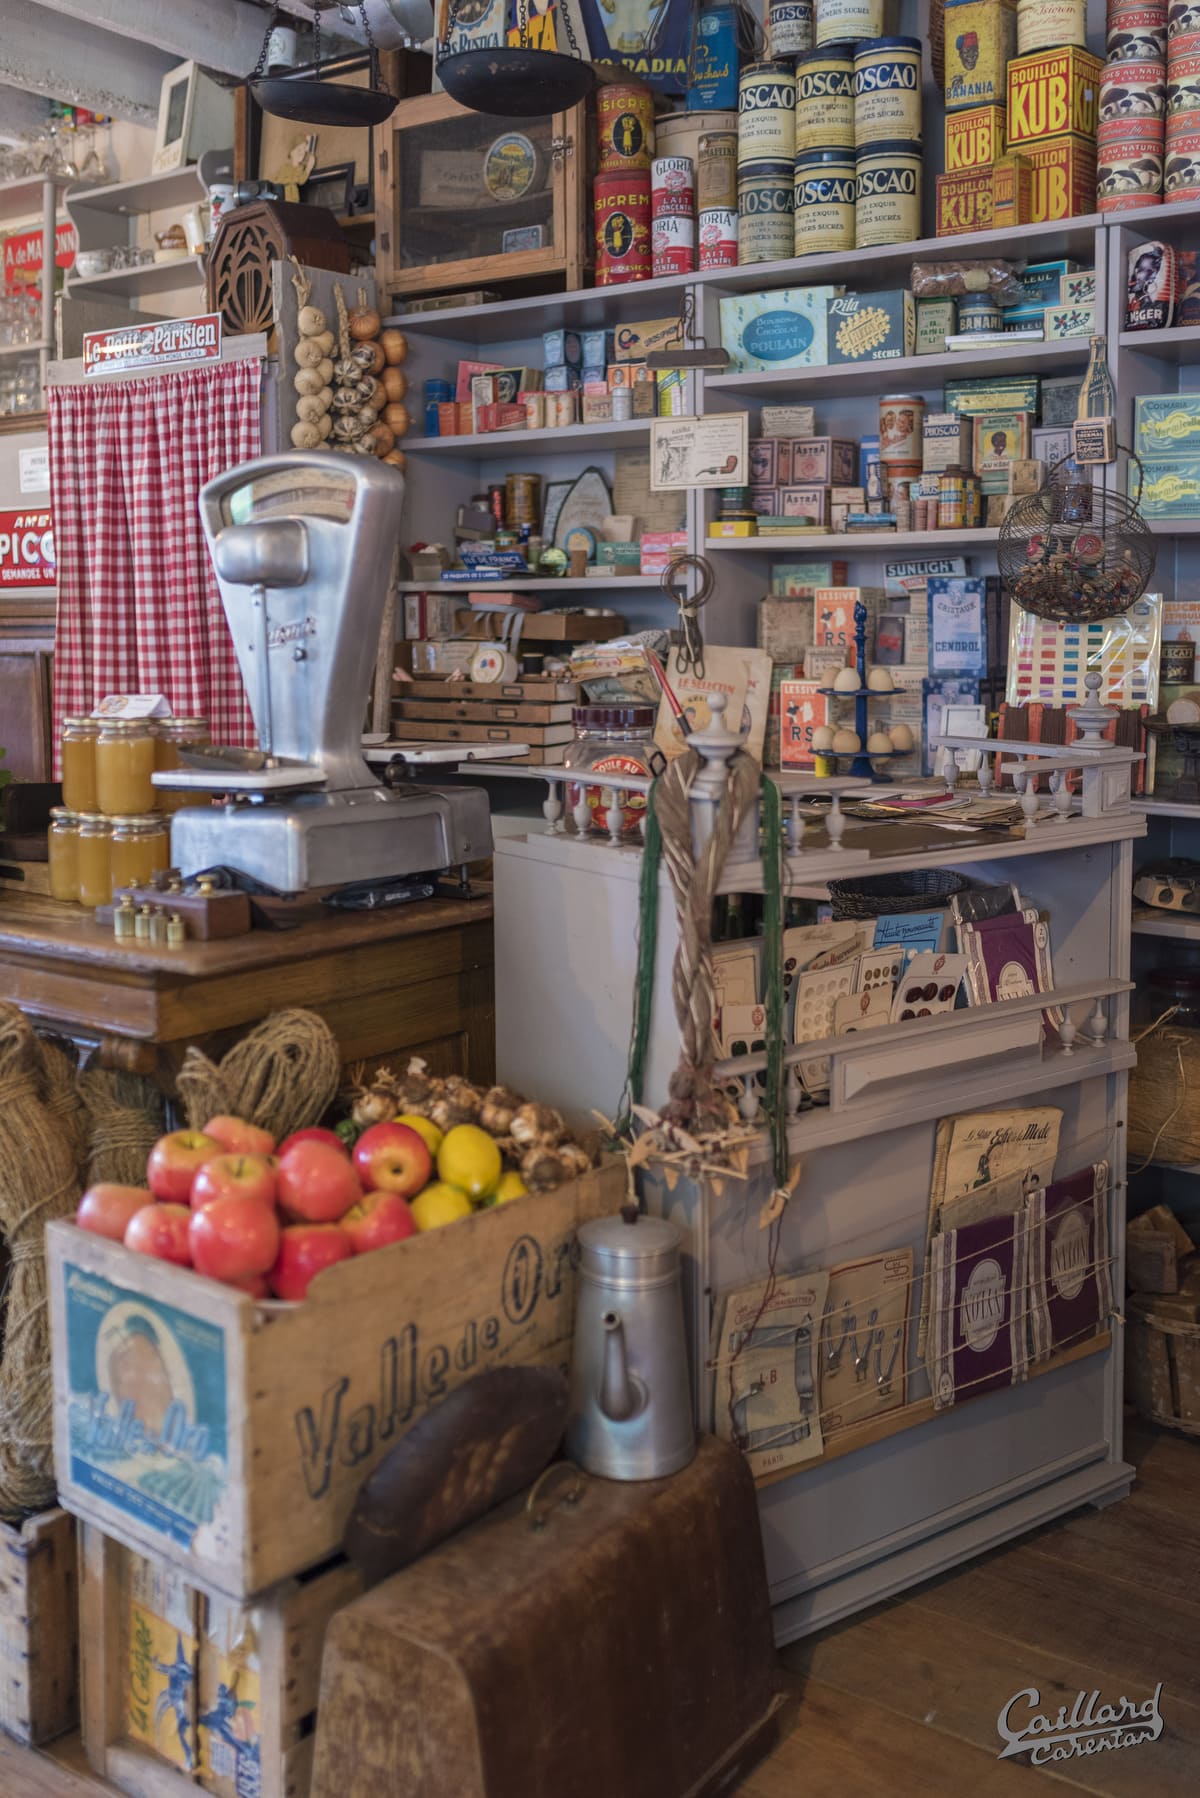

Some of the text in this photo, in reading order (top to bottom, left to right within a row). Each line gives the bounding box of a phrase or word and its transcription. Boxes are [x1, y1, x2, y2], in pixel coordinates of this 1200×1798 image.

[1011, 60, 1067, 84] BOUILLON
[946, 81, 994, 99] BANANIA
[1011, 76, 1068, 140] KUB
[948, 117, 990, 134] BOUILLON
[948, 127, 991, 169] KUB
[942, 179, 992, 196] BOUILLON
[595, 194, 650, 211] SICREM
[663, 196, 690, 205] LAIT
[941, 191, 992, 228] KUB
[1130, 309, 1163, 321] NIGER
[86, 339, 100, 363] Le
[154, 322, 217, 354] Parisien
[750, 337, 808, 353] POULAIN
[924, 425, 960, 437] PHOSCAO
[887, 560, 957, 577] SUNLIGHT
[820, 591, 855, 601] LESSIVE
[825, 631, 847, 647] R S
[935, 641, 980, 653] CENDROL
[791, 726, 801, 741] R
[623, 763, 639, 775] AU
